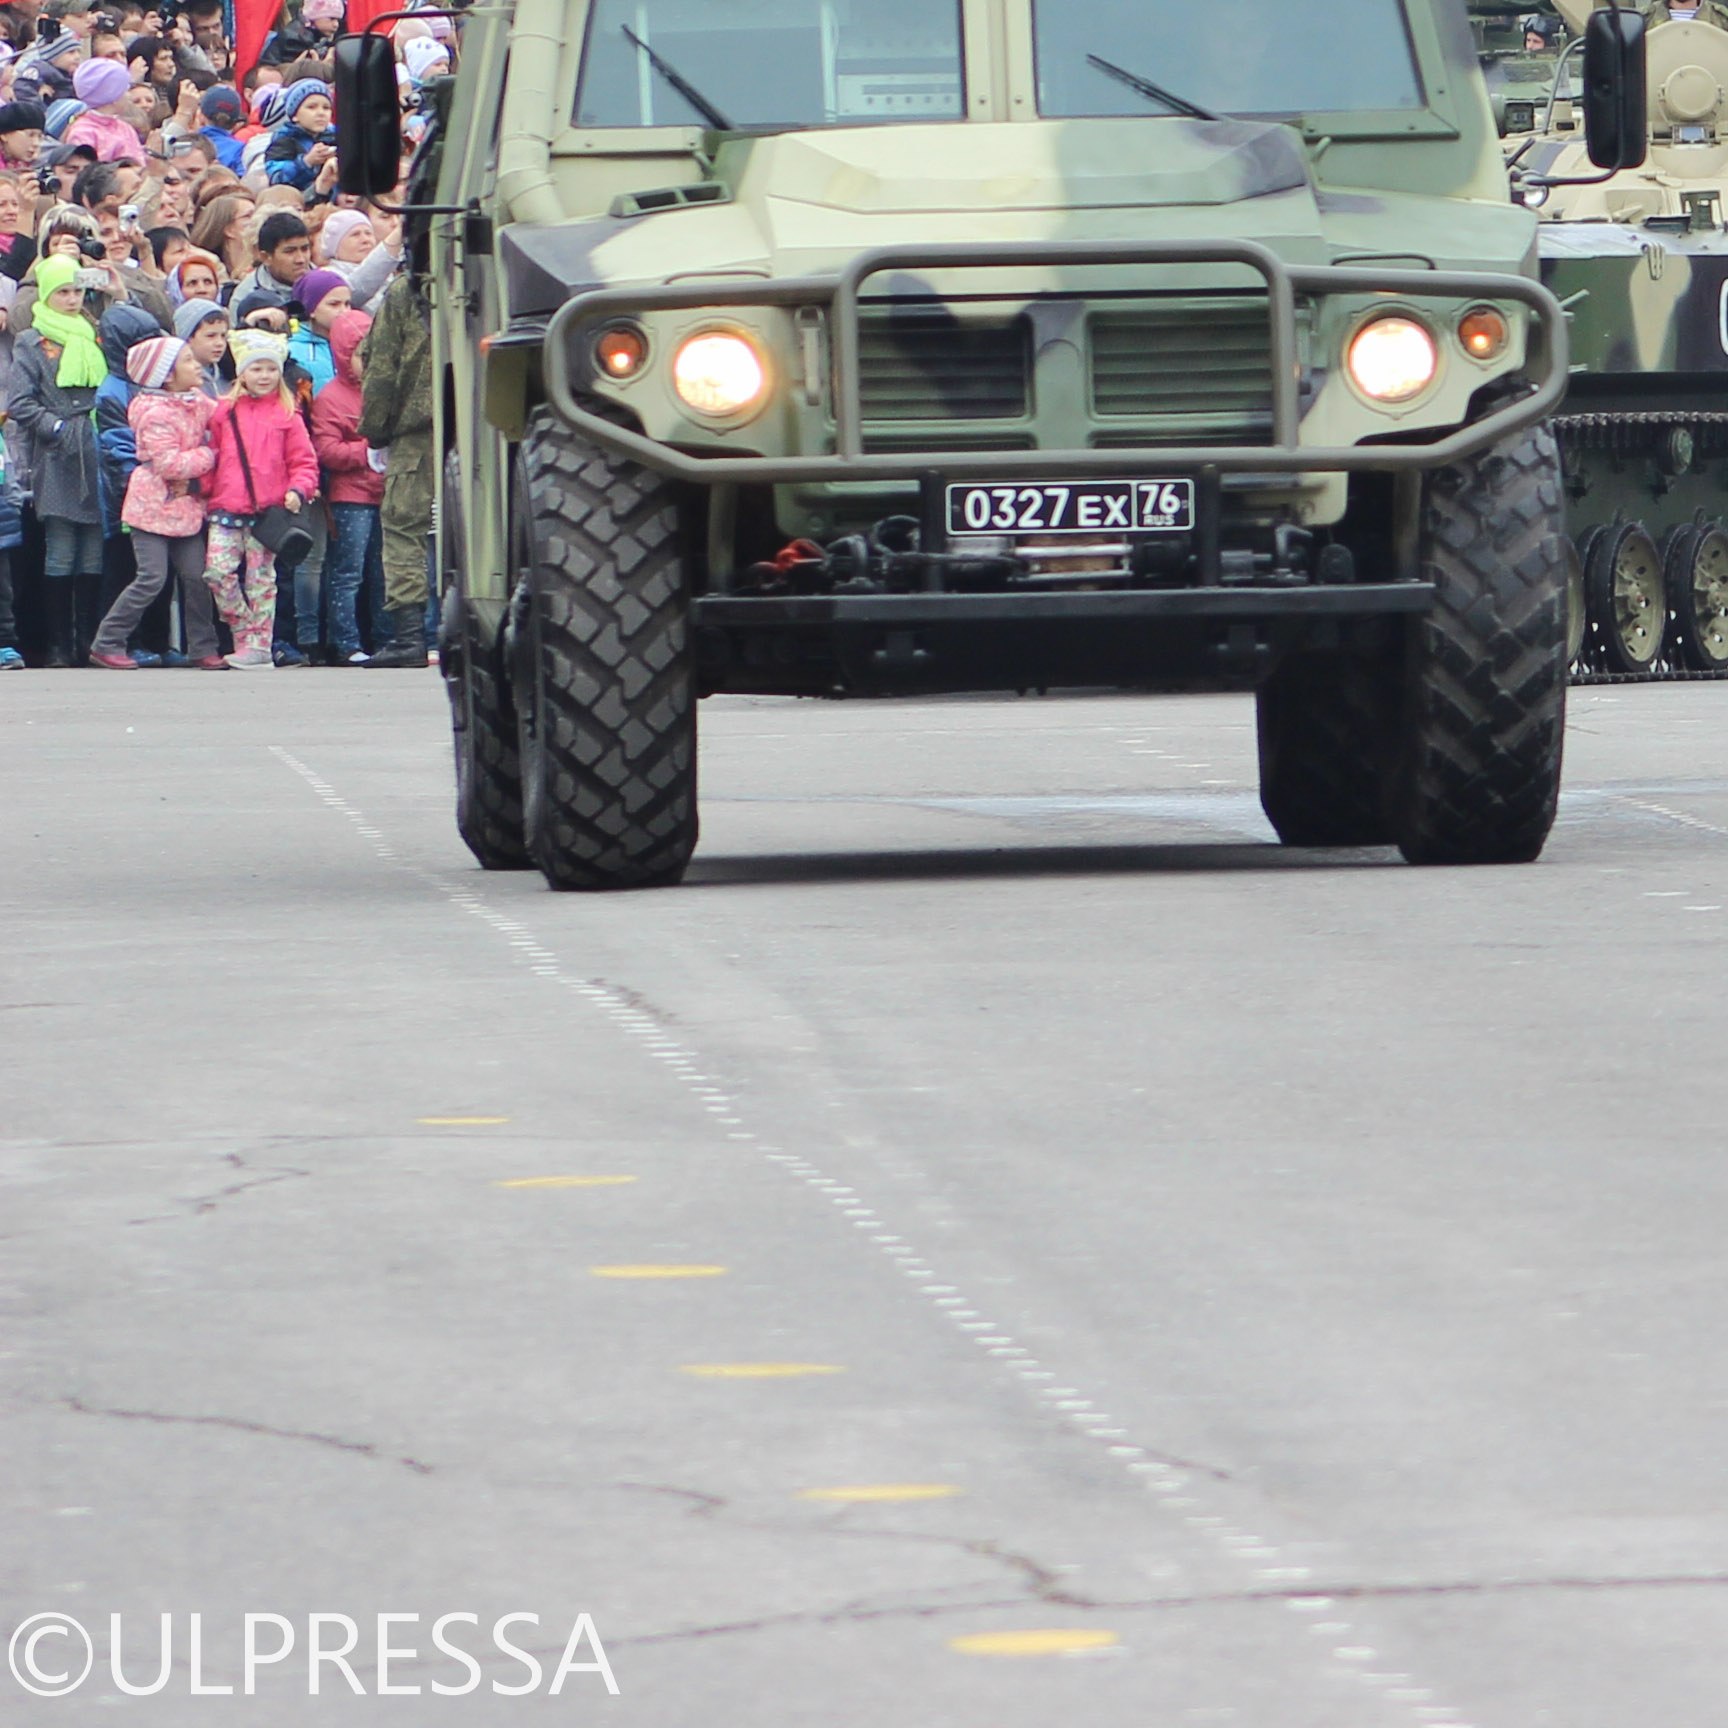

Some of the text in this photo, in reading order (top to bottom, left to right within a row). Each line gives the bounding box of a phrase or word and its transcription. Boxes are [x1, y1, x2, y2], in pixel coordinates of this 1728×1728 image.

[963, 487, 1069, 529] 0327
[1138, 483, 1181, 515] 76
[1143, 513, 1175, 526] RUS
